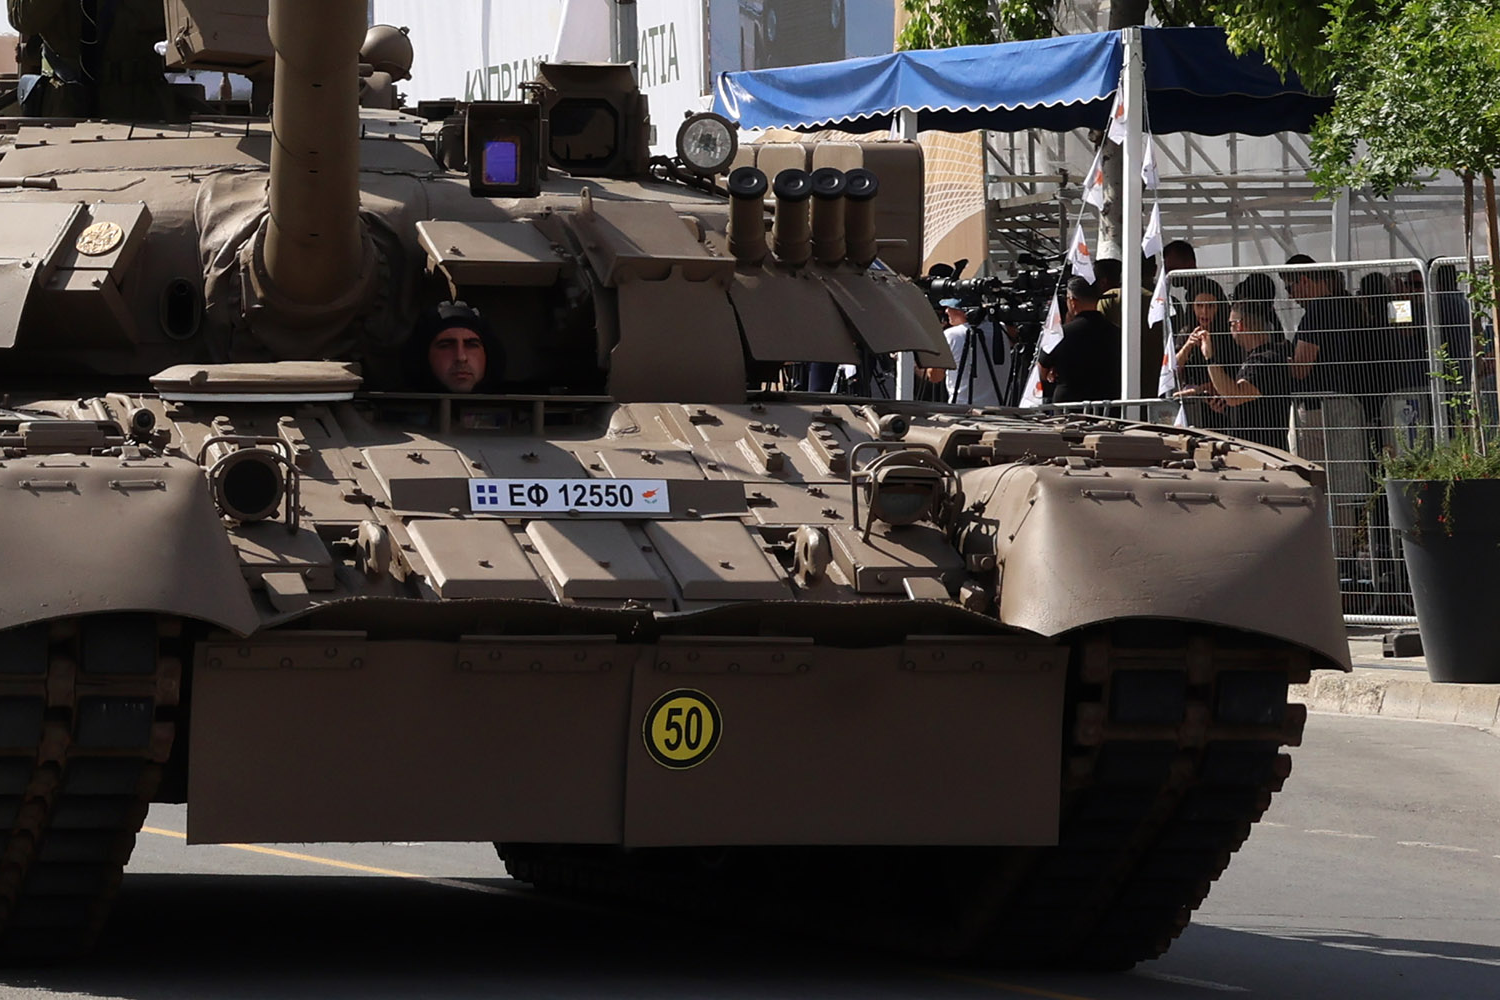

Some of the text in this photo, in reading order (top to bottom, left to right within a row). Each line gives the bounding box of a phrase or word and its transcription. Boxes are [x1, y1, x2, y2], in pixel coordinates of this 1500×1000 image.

[508, 483, 634, 507] ΕΦ 12550
[664, 706, 703, 752] 50
